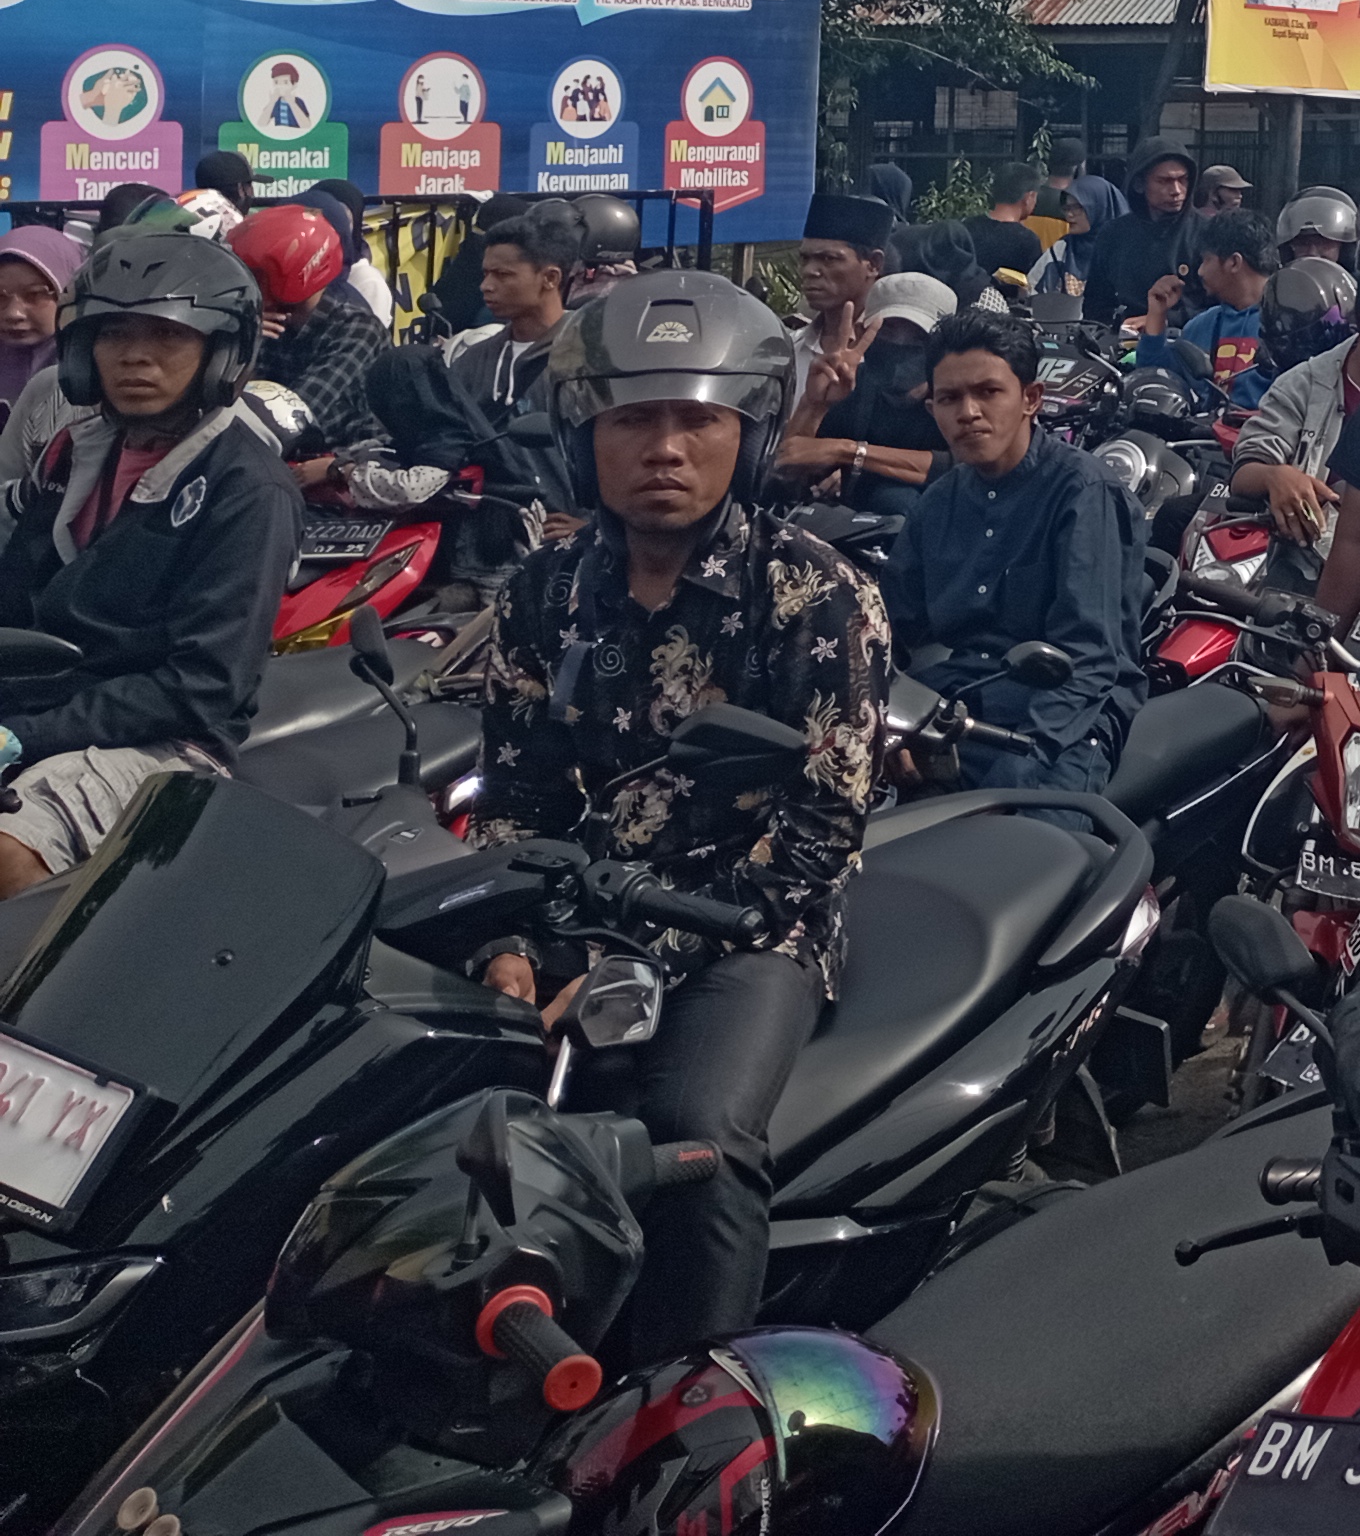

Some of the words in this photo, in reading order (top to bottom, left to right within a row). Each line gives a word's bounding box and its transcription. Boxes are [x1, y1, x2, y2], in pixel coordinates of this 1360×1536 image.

[65, 144, 159, 171] Mencuci
[238, 143, 330, 169] Memakai
[401, 143, 480, 171] Menjaga
[546, 142, 623, 167] Menjauhi
[670, 140, 760, 164] Mengurangi
[415, 174, 465, 195] Jarak
[537, 171, 629, 193] Kerumunan
[680, 167, 749, 188] Mobilitas
[1302, 851, 1335, 877] BM
[1247, 1421, 1331, 1482] BM
